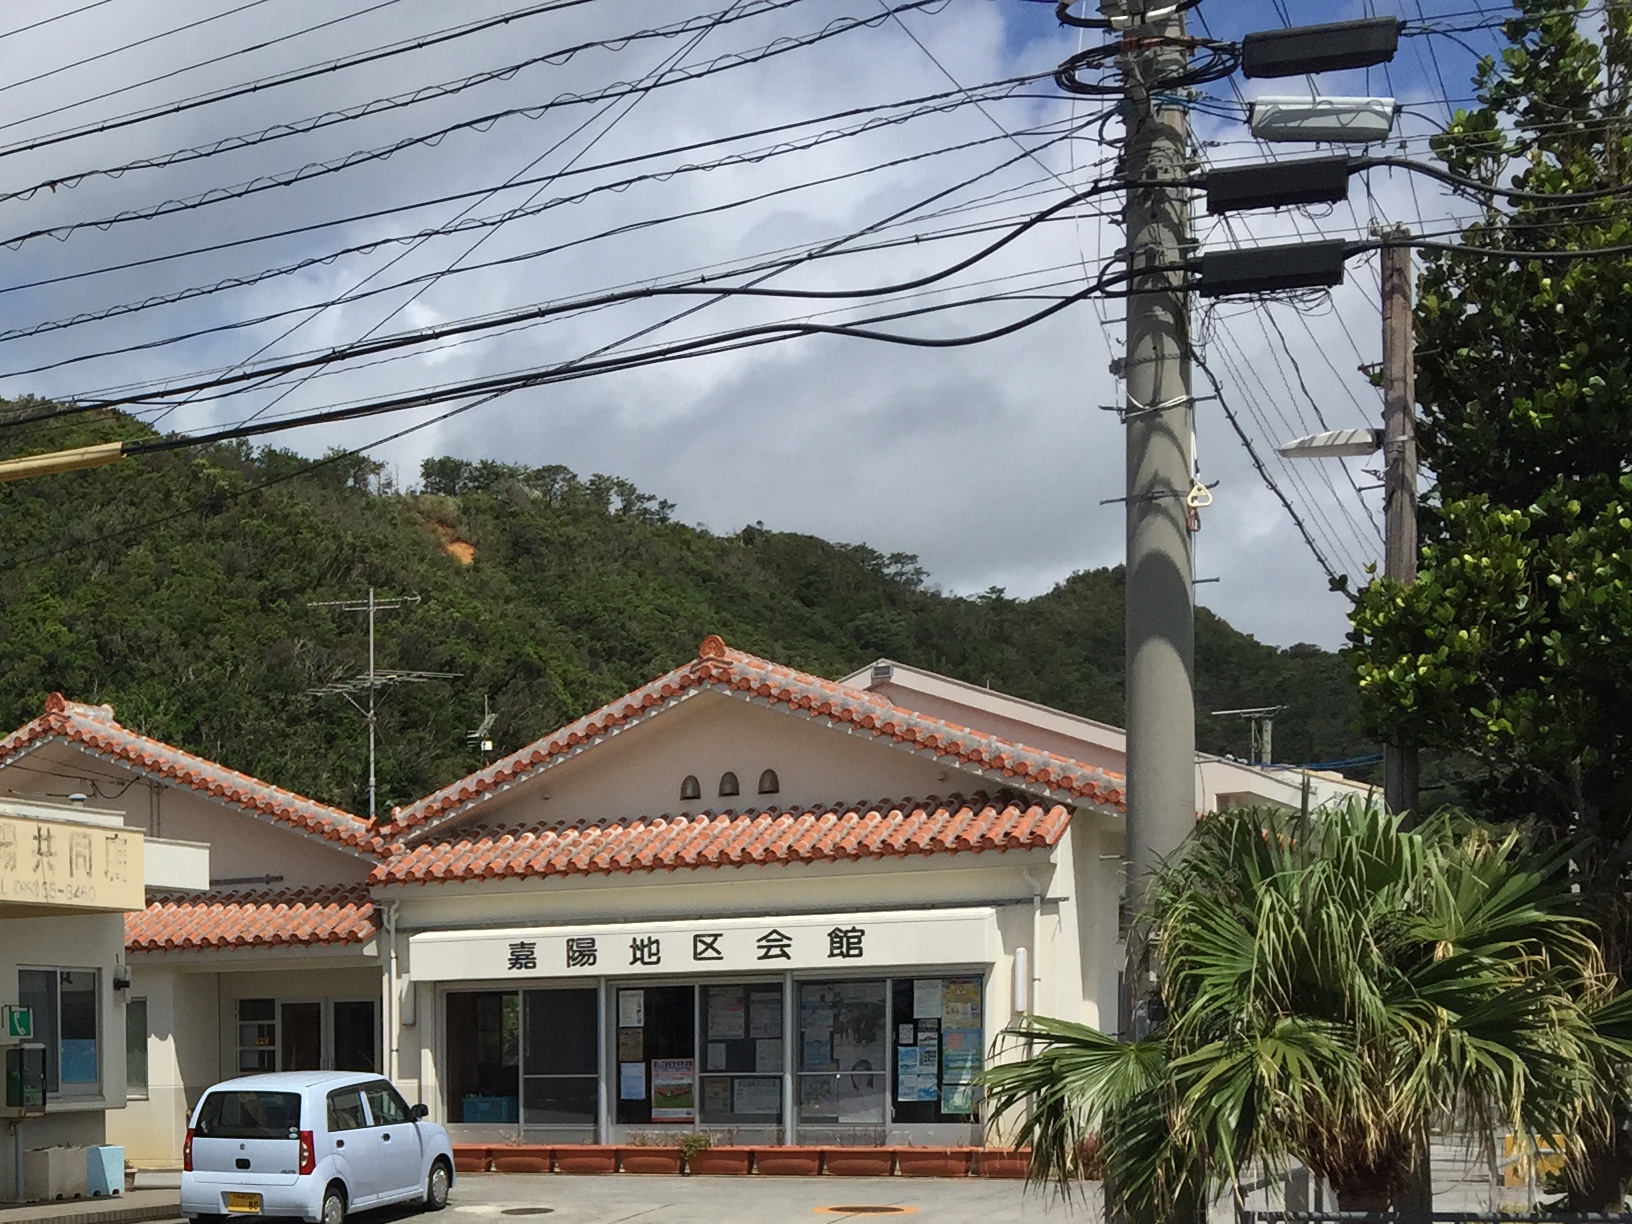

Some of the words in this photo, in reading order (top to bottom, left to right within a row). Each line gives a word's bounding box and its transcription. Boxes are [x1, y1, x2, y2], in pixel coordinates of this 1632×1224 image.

[507, 926, 866, 971] 嘉陽地区会館
